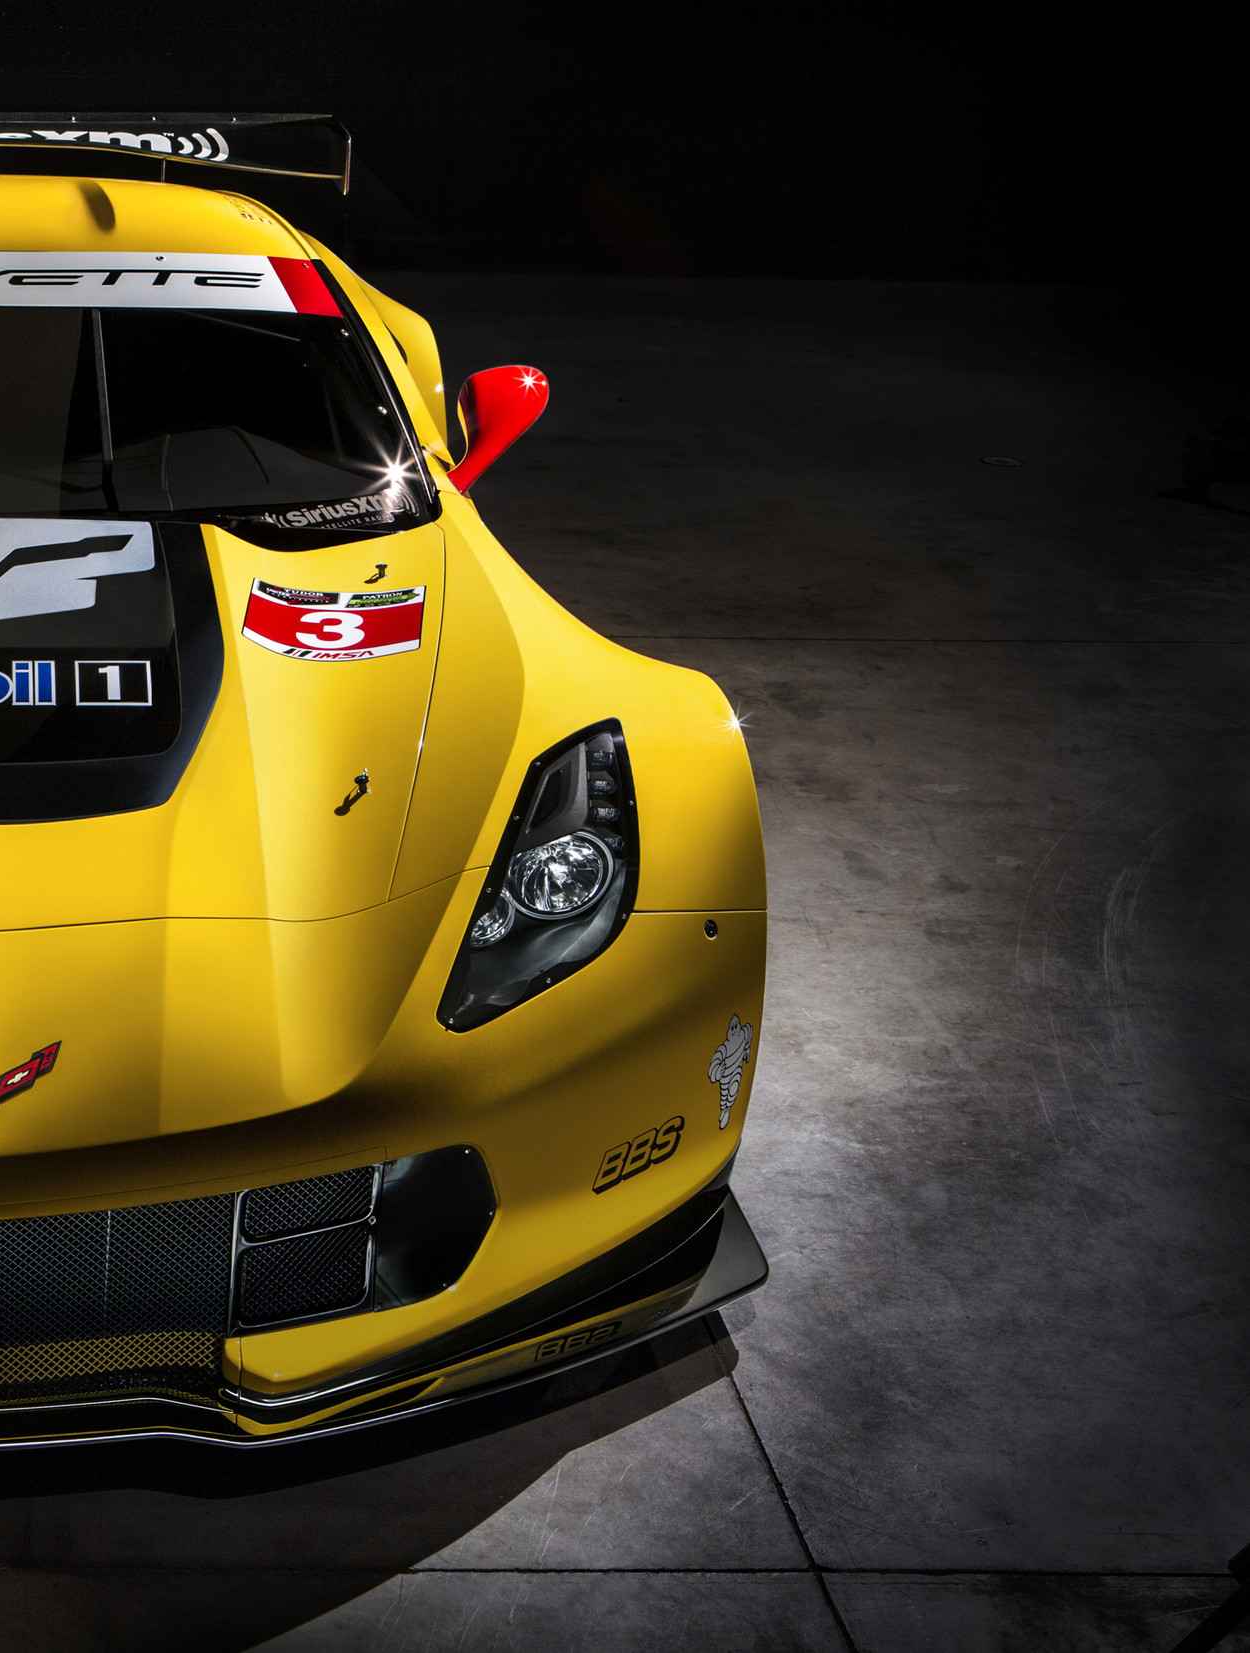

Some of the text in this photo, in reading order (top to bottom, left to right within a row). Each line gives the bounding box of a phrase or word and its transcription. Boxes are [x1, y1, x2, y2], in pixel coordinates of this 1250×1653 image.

[321, 518, 362, 529] TELLITE
[283, 588, 324, 597] TUDOR
[295, 611, 365, 649] 3
[312, 650, 374, 659] IMSA
[98, 665, 121, 700] 1
[592, 1115, 685, 1195] BBS
